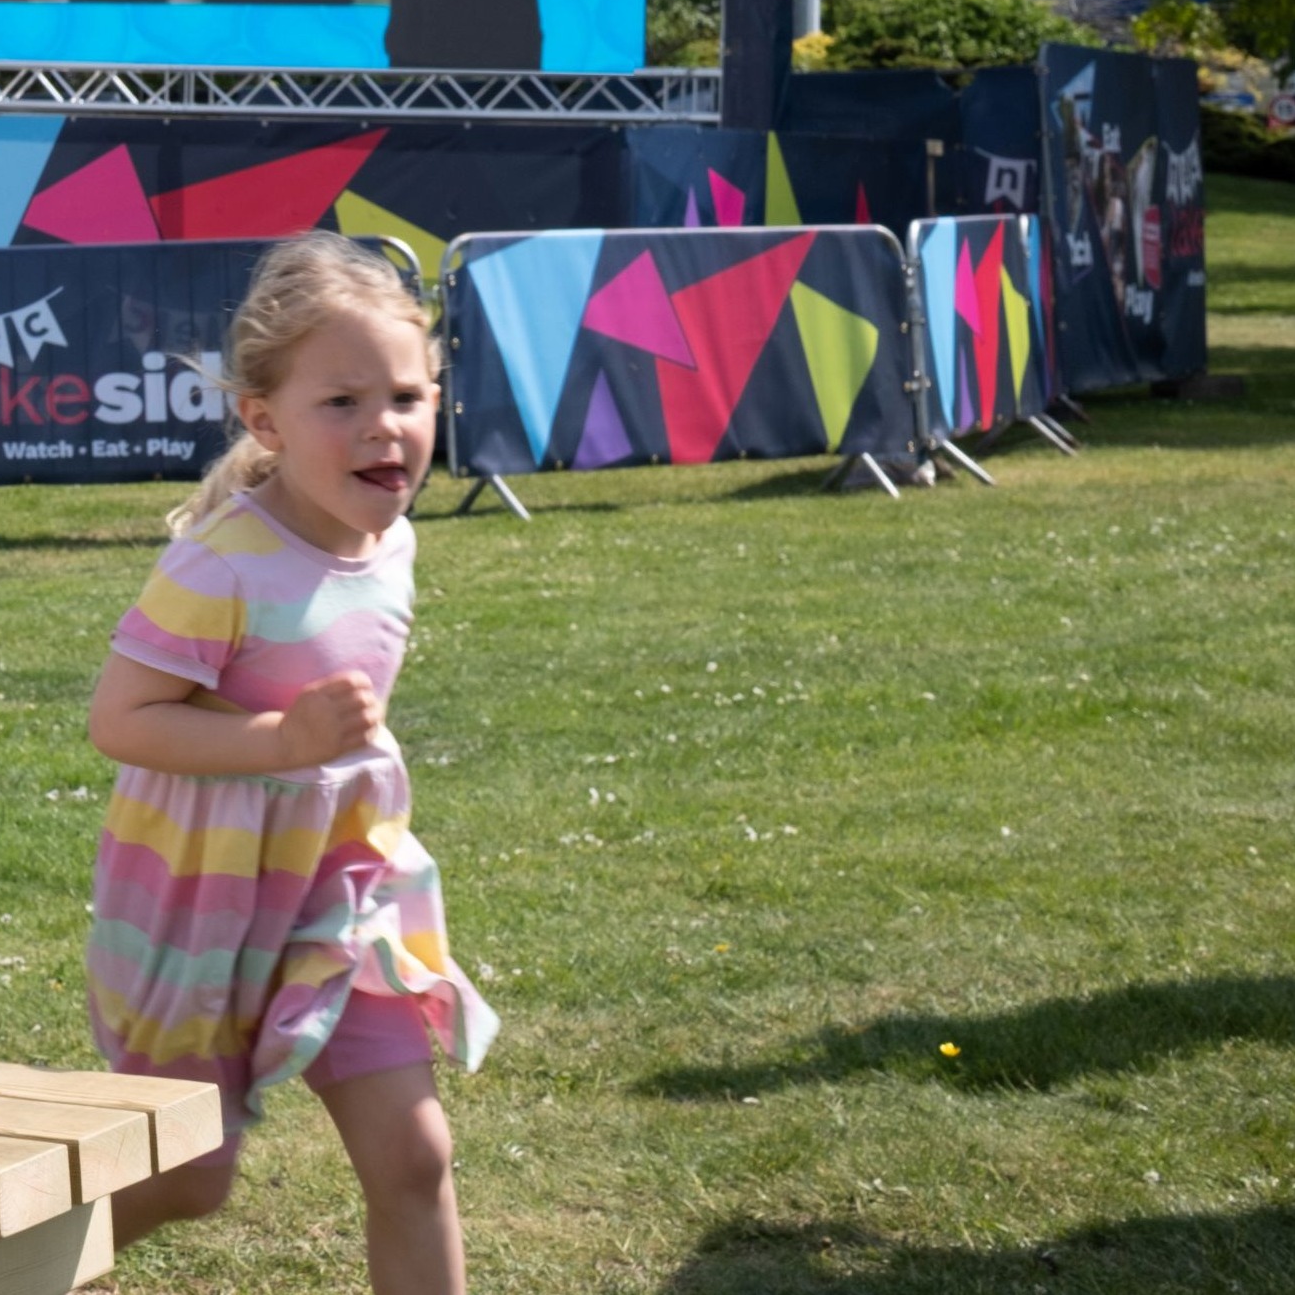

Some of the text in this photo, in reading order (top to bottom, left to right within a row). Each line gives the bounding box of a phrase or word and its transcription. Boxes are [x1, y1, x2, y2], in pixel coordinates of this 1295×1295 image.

[3, 438, 195, 460] Watch Eat Play
